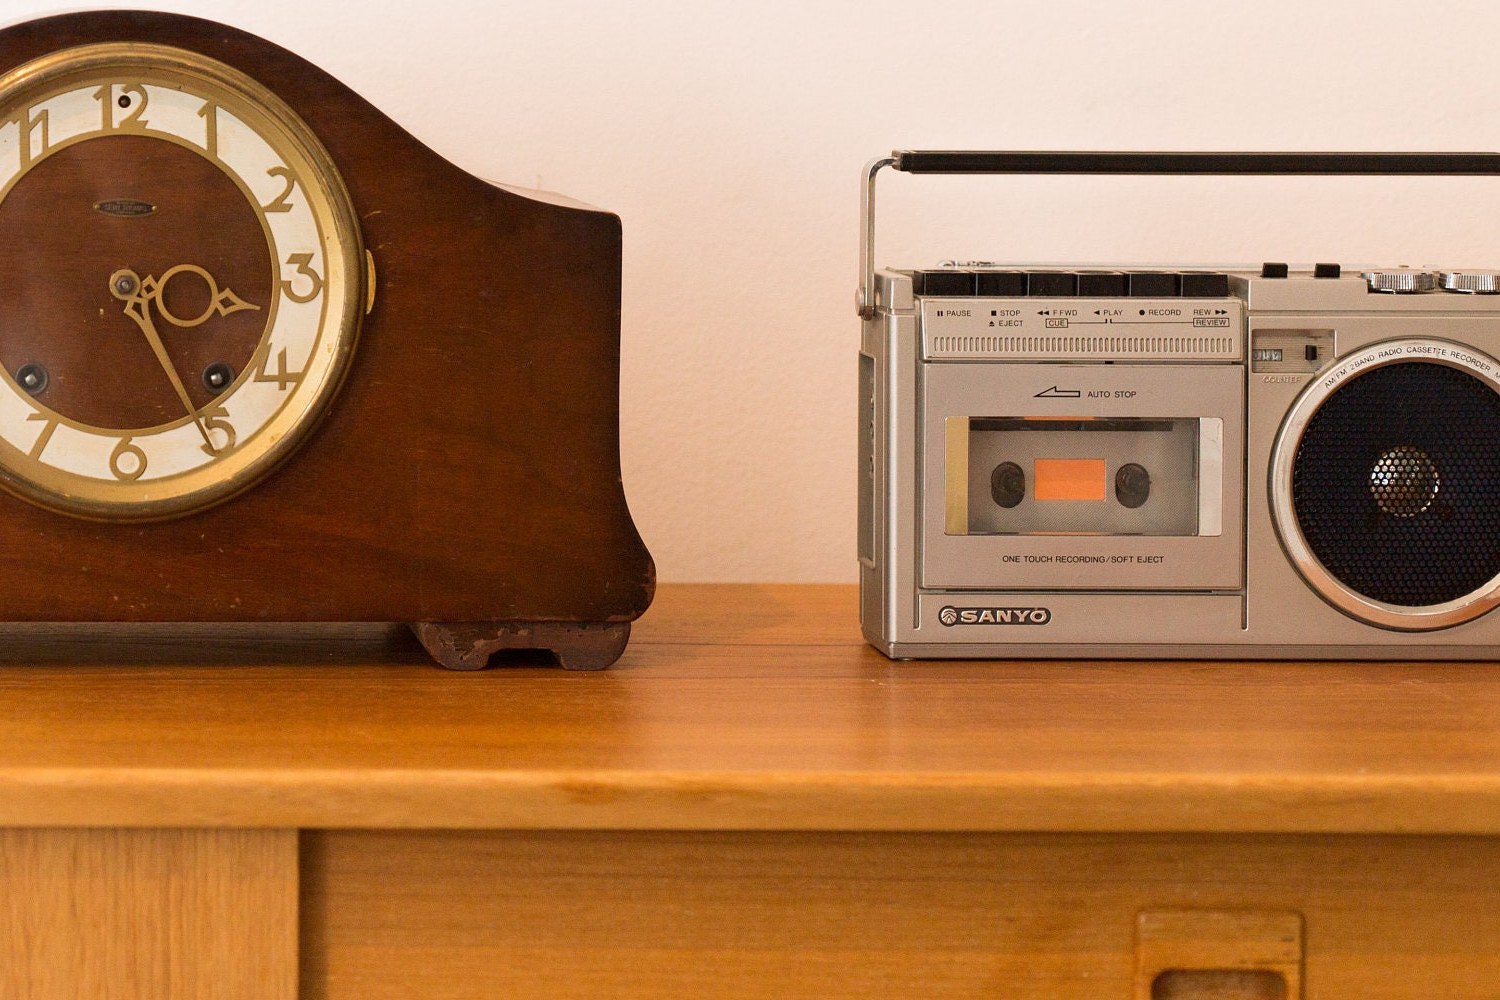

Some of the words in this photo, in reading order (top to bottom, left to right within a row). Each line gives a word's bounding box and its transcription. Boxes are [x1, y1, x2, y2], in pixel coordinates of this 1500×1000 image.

[93, 83, 148, 131] 12
[197, 100, 218, 156] 1
[10, 107, 49, 170] 11
[262, 166, 297, 214] 2
[282, 252, 323, 304] 3
[946, 309, 972, 317] PAUSE
[1000, 309, 1021, 317] STOP
[1103, 309, 1123, 317] PLAY
[1193, 308, 1212, 316] REW
[998, 319, 1024, 327] EJECT
[1048, 319, 1065, 327] CUE
[254, 342, 302, 391] 4
[1378, 347, 1403, 359] RADIO
[1406, 346, 1447, 356] CASSETTE
[1450, 350, 1491, 372] RECORDER
[1262, 375, 1300, 384] COUNTER
[1087, 391, 1110, 399] AUTO
[1114, 391, 1137, 399] STOP
[26, 408, 60, 462] 7
[200, 406, 238, 455] 5
[109, 436, 148, 481] 6
[1002, 555, 1021, 563] ONE
[1024, 555, 1052, 563] TOUCH
[1137, 555, 1164, 564] EJECT
[960, 608, 1048, 623] SANYO
